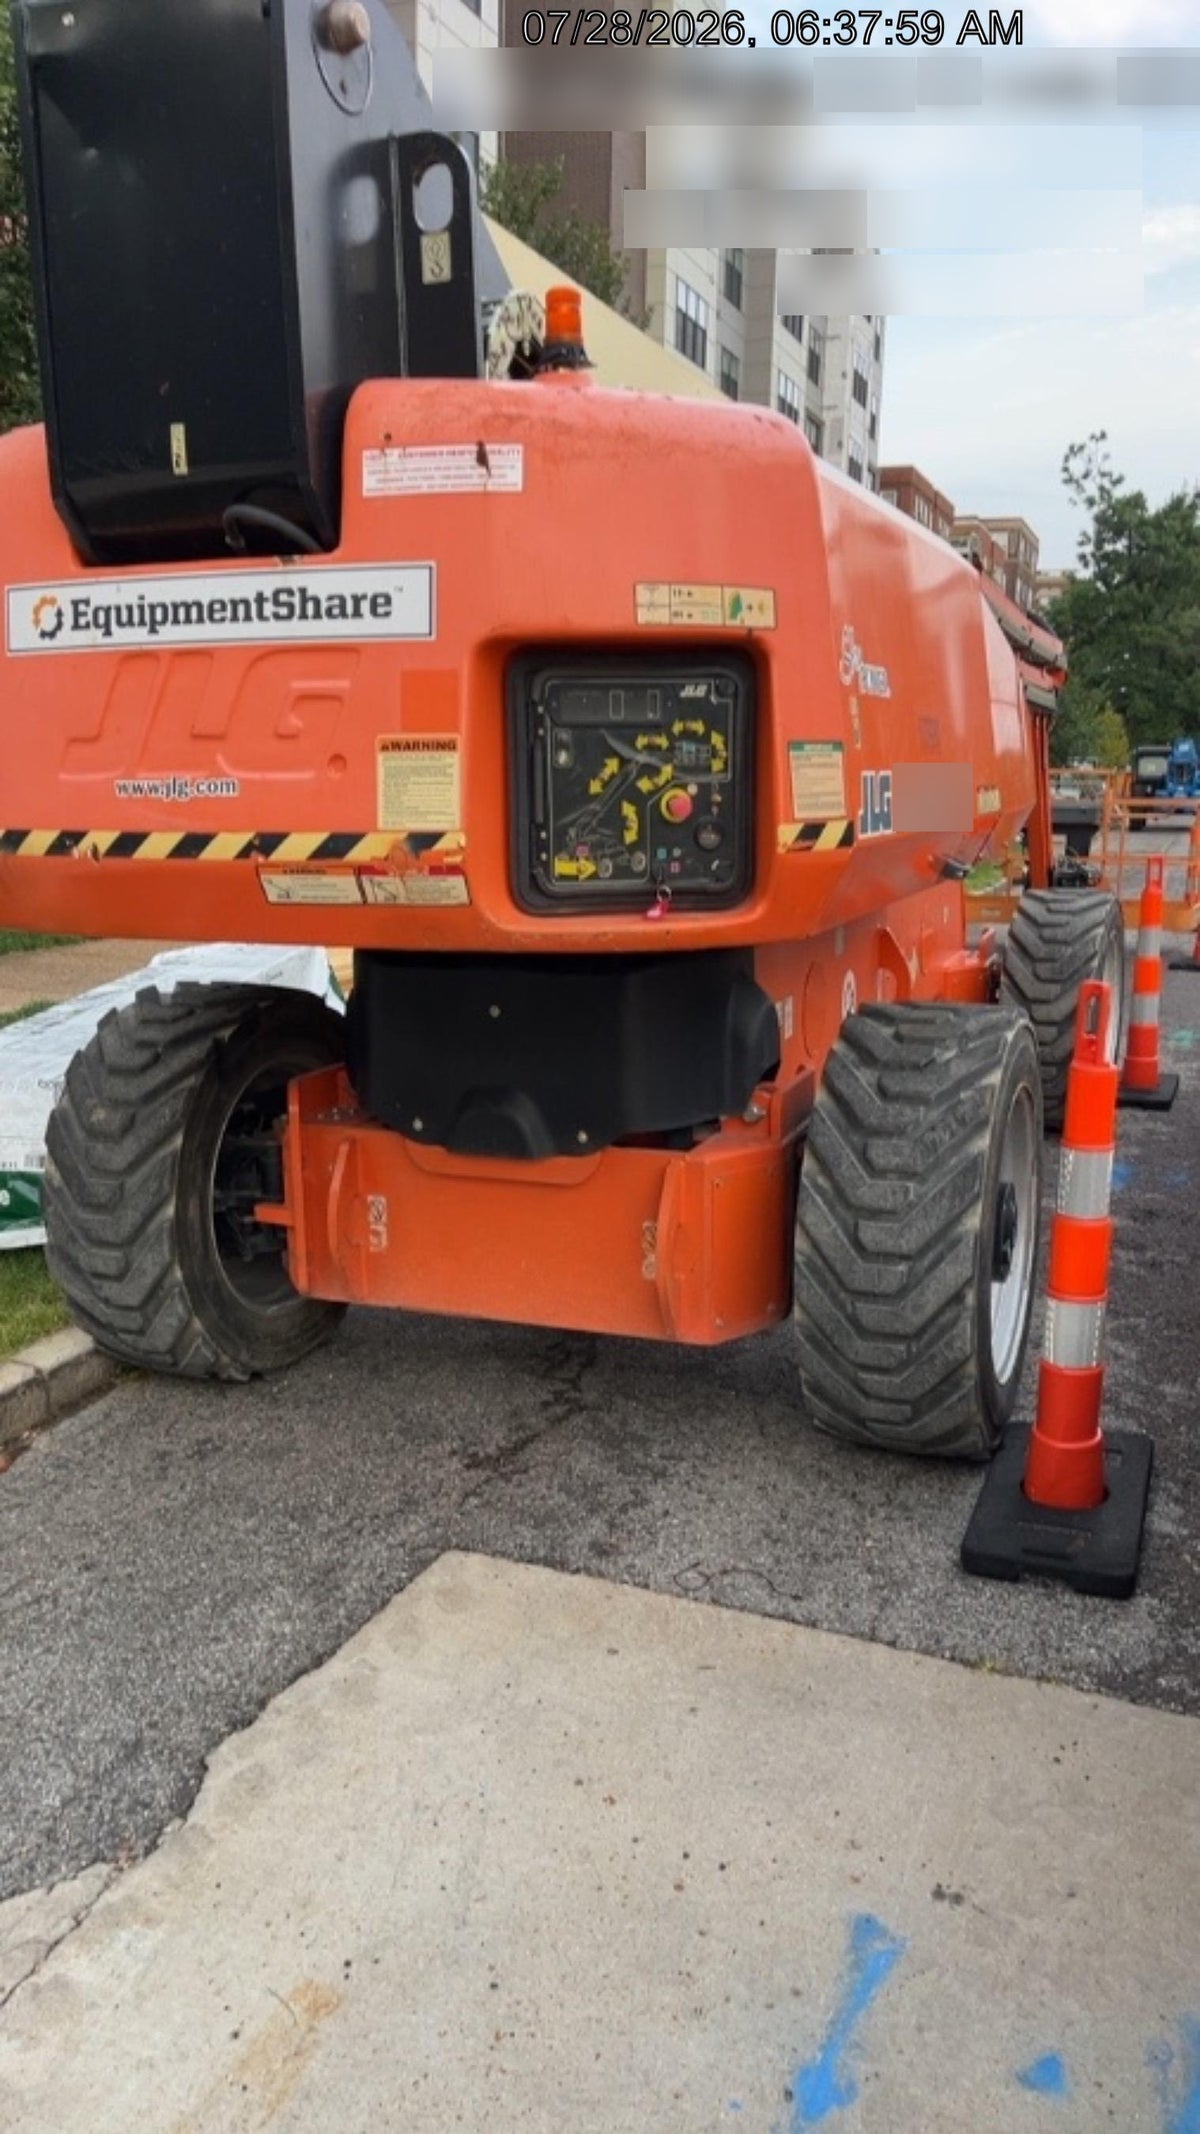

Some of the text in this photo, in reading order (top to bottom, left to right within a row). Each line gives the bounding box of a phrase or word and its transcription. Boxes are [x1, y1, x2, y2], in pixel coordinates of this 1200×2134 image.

[71, 586, 392, 637] EquipmentShare
[58, 648, 360, 779] JLG
[390, 740, 457, 752] WARNING
[115, 777, 237, 800] www.jlg.com
